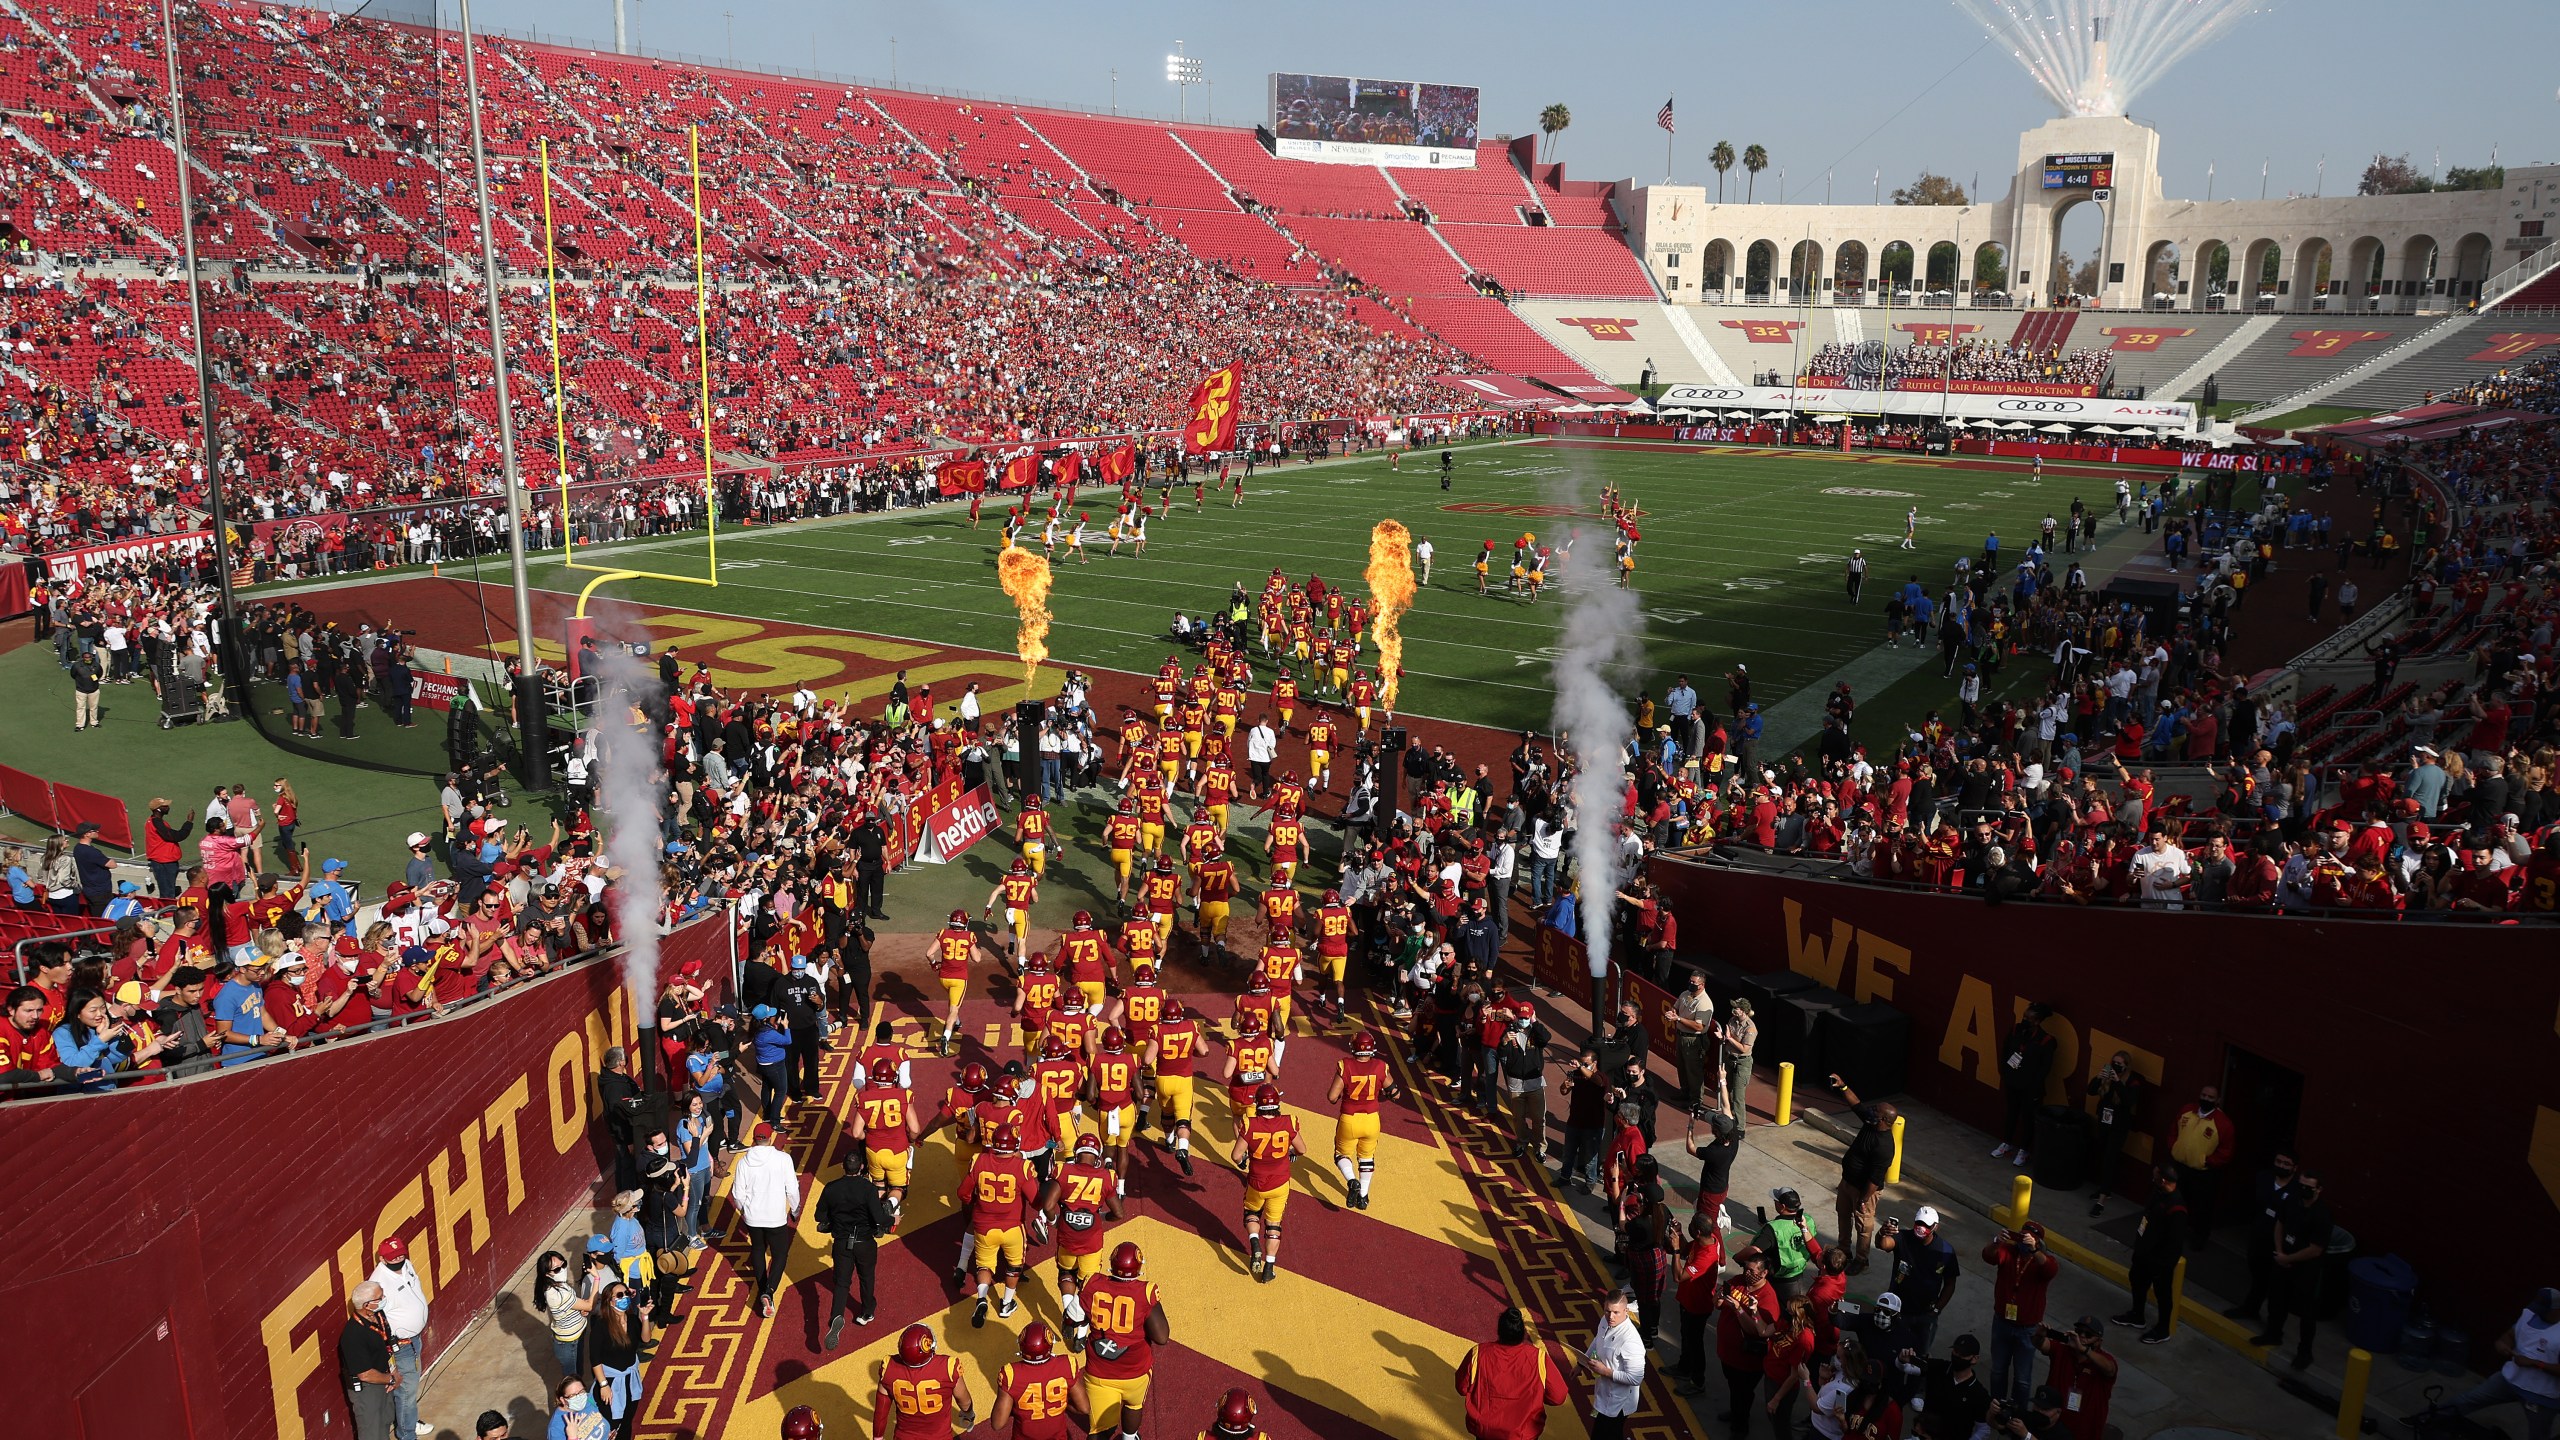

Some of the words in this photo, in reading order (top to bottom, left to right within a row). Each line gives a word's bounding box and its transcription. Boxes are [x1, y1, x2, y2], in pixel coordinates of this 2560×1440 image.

[1384, 152, 1420, 161] SmartStop
[2064, 156, 2087, 164] MUSCLE
[2066, 175, 2088, 184] 4:40
[2096, 171, 2106, 186] SC
[2096, 191, 2107, 200] 25
[1592, 323, 1621, 336] 20
[1752, 326, 1783, 337] 32
[1924, 330, 1950, 340] 12
[2124, 334, 2160, 344] 33
[2315, 338, 2340, 350] 3
[1844, 373, 1900, 392] Allstate
[1907, 382, 1931, 390] RUTH
[1933, 382, 1942, 390] C.
[1972, 384, 2004, 394] FAMILY
[2006, 384, 2032, 394] BAND
[2034, 386, 2074, 396] SECTION
[1720, 428, 1736, 442] SC
[1697, 448, 1958, 467] USC
[2182, 452, 2204, 468] WE
[938, 468, 981, 490] USC
[1008, 457, 1030, 485] U
[1290, 594, 1300, 606] 13
[1330, 597, 1338, 608] 9
[1270, 618, 1277, 630] 7
[1354, 610, 1358, 622] 1
[1294, 626, 1305, 639] 16
[1315, 642, 1326, 652] 15
[1334, 650, 1349, 662] 52
[1232, 667, 1241, 679] 2
[422, 682, 459, 696] PECHANG
[422, 692, 442, 700] RESORT
[1156, 682, 1173, 692] 70
[1278, 684, 1294, 698] 26
[1358, 686, 1368, 700] 7
[1218, 694, 1235, 708] 90
[1185, 710, 1202, 725] 97
[1124, 726, 1142, 742] 40
[1161, 737, 1180, 753] 36
[1207, 773, 1229, 791] 50
[1141, 796, 1162, 814] 53
[1280, 788, 1301, 807] 24
[912, 805, 922, 834] SC
[936, 801, 998, 855] nextiva
[1024, 814, 1042, 834] 41
[1114, 823, 1136, 840] 29
[1274, 826, 1298, 846] 89
[1150, 878, 1174, 900] 39
[1204, 869, 1228, 891] 77
[1006, 880, 1032, 902] 37
[1268, 896, 1294, 918] 84
[1128, 928, 1153, 951] 38
[1542, 929, 1554, 967] SC
[942, 938, 969, 961] 36
[1069, 938, 1100, 963] 73
[1267, 956, 1297, 980] 87
[1568, 944, 1580, 984] SC
[1026, 984, 1055, 1008] 49
[1128, 996, 1160, 1022] 68
[1162, 1031, 1194, 1060] 57
[1238, 1048, 1270, 1073] 69
[1041, 1071, 1075, 1099] 62
[1100, 1062, 1128, 1092] 19
[1246, 1072, 1263, 1081] USC
[1350, 1074, 1377, 1101] 71
[864, 1098, 902, 1129] 78
[1252, 1130, 1291, 1160] 79
[978, 1170, 1016, 1204] 63
[1066, 1174, 1104, 1205] 74
[1065, 1213, 1094, 1226] USC
[1091, 1290, 1136, 1335] 60
[892, 1378, 944, 1416] 66
[1018, 1376, 1069, 1421] 49
